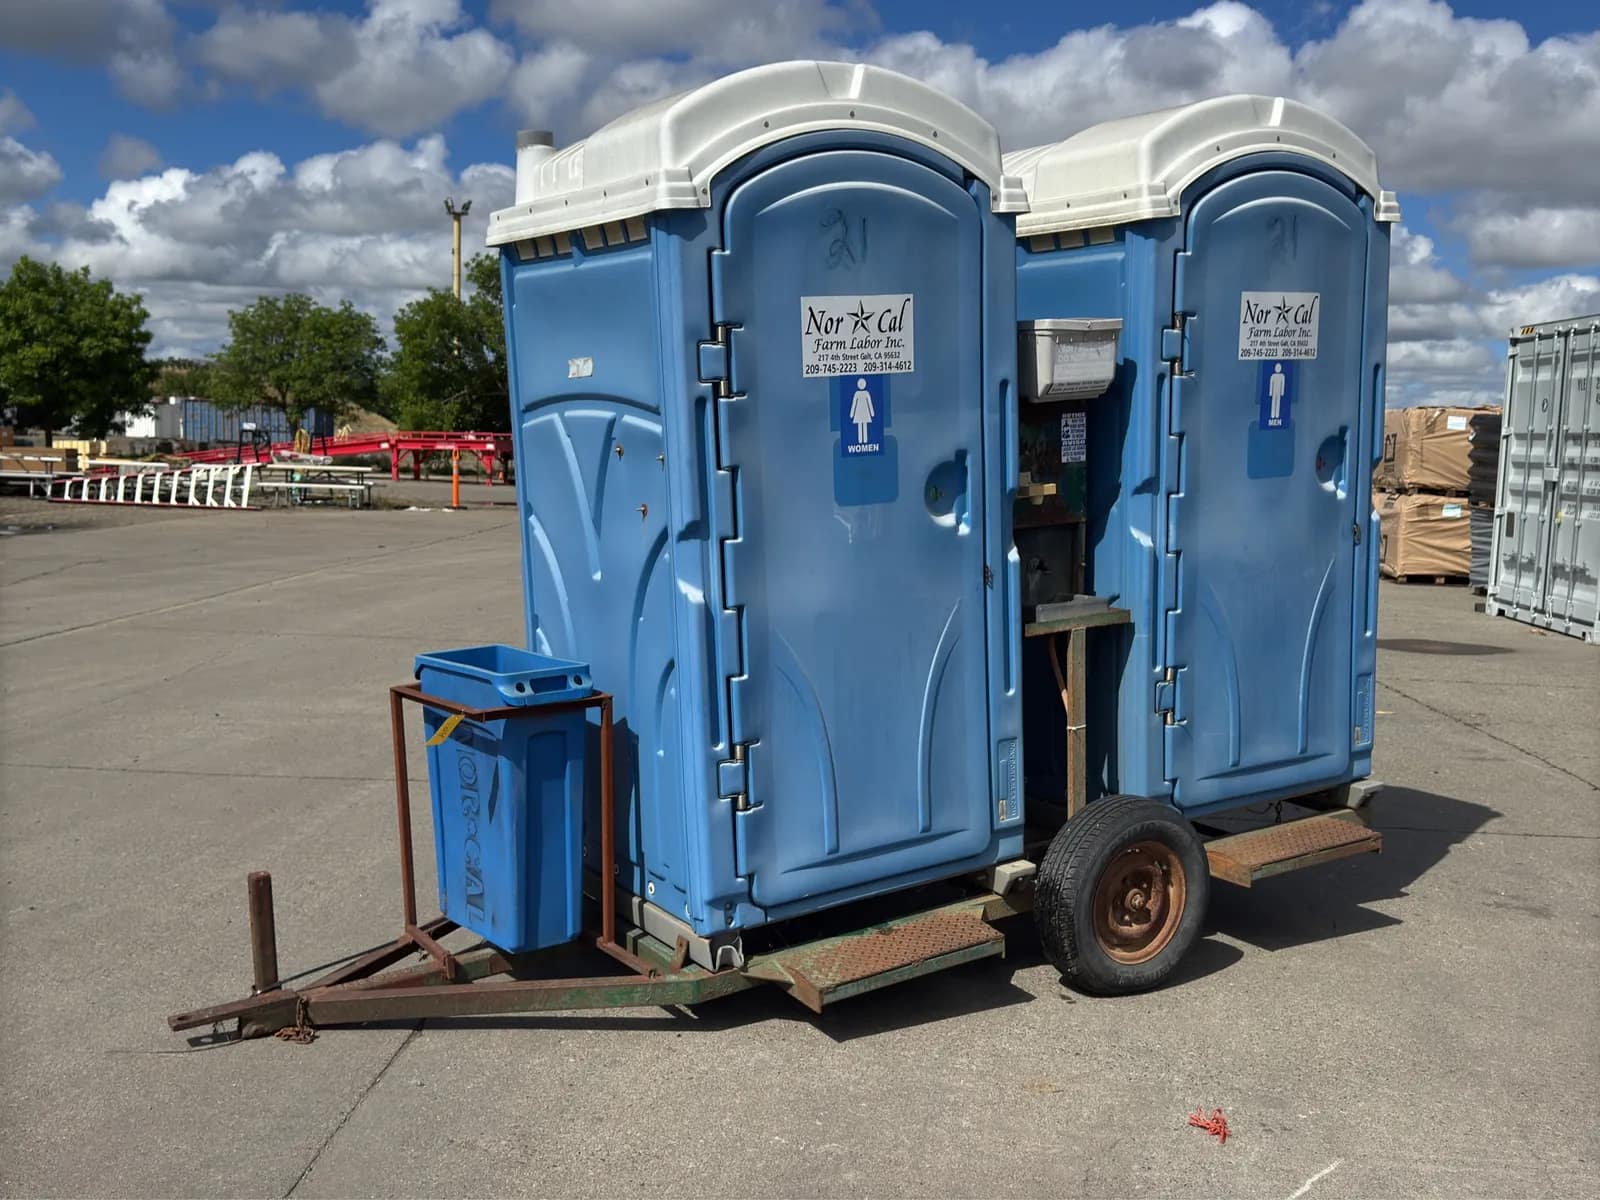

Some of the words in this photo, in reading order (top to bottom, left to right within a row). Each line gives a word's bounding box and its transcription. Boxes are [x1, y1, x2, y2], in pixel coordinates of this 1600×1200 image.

[805, 306, 844, 336] Nor
[877, 298, 911, 333] Cal
[1243, 299, 1271, 325] Nor
[1294, 295, 1319, 324] Cal
[1247, 326, 1271, 339] Farm
[1273, 325, 1297, 338] Labor
[1298, 327, 1312, 338] Inc.
[813, 338, 847, 353] Farm
[850, 335, 882, 350] Labor
[885, 336, 905, 349] Inc.
[830, 353, 840, 361] 4th
[842, 353, 859, 361] Street
[884, 351, 901, 359] 95632
[805, 363, 857, 374] 209-745-2223
[863, 361, 912, 372] 209-314-4612
[847, 443, 880, 453] WOMEN
